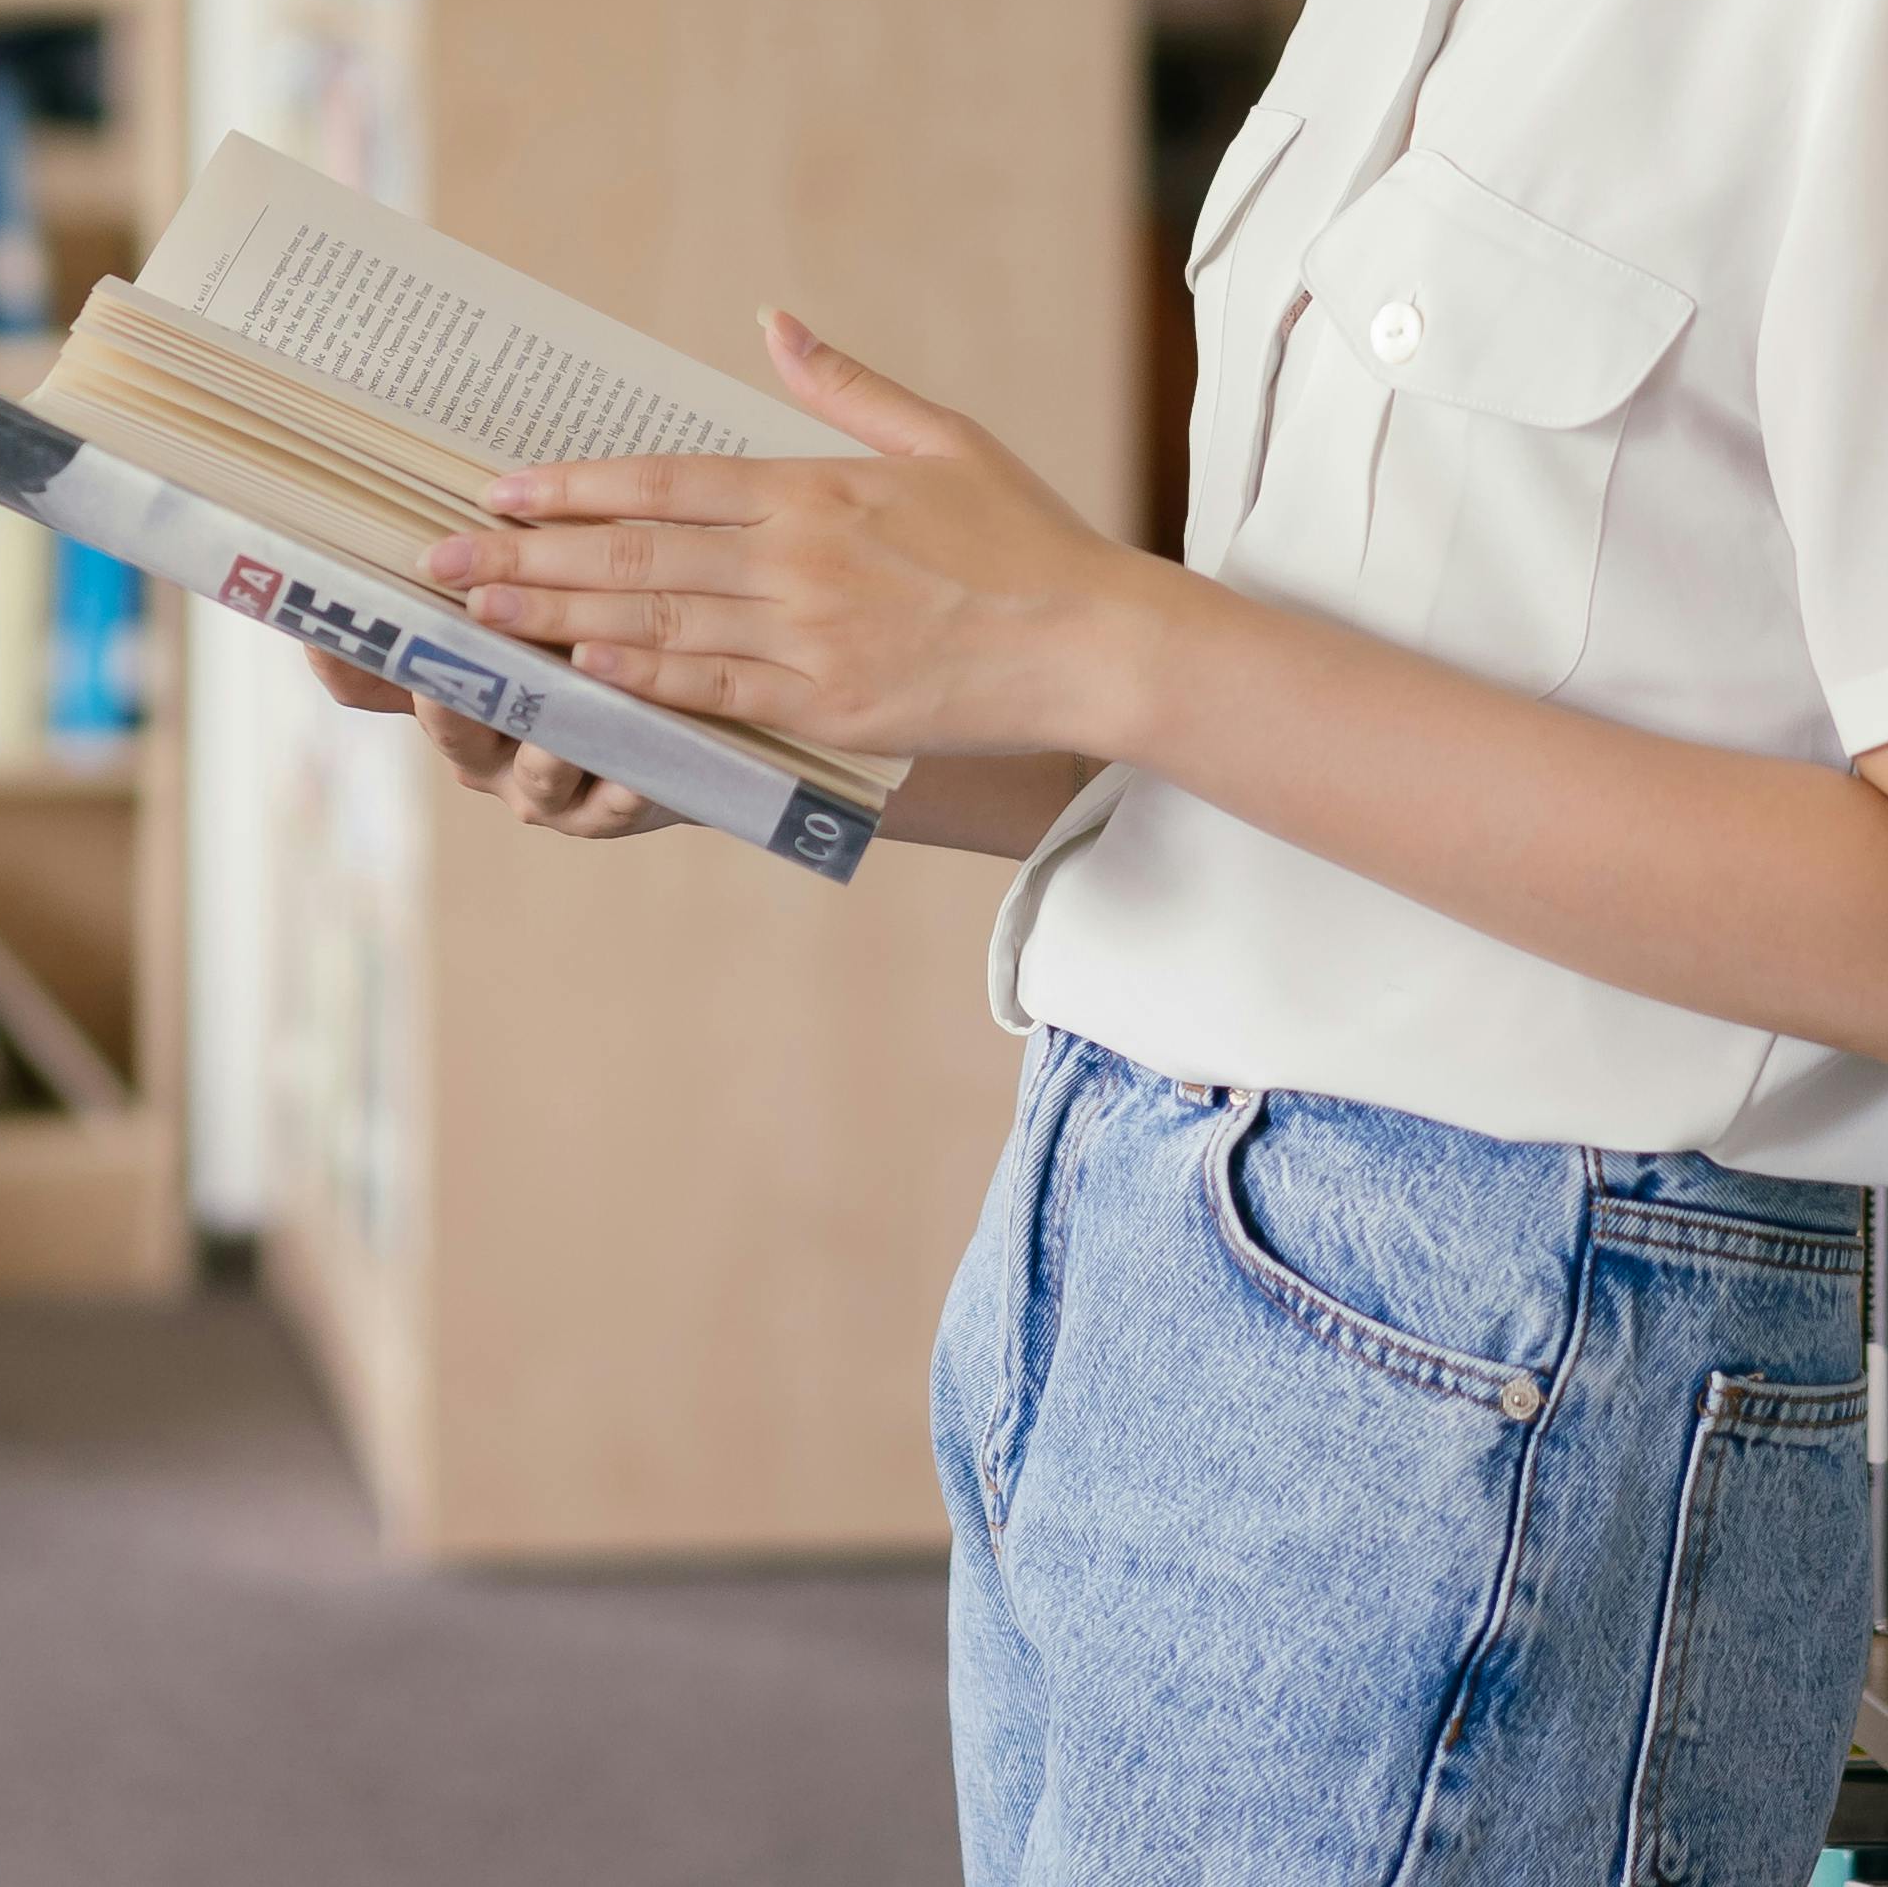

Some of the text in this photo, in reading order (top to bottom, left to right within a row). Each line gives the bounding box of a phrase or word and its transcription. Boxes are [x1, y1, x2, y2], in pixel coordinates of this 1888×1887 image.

[206, 253, 229, 281] Dealers
[260, 255, 313, 332] East Side Operation
[244, 279, 276, 320] Department
[283, 305, 306, 334] the first
[301, 275, 346, 343] dropped by and
[311, 257, 380, 366] the same time, some of the
[358, 305, 397, 366] and reclaiming the
[379, 299, 423, 367] of Operation Pressure
[394, 329, 428, 383] markets did not
[406, 312, 460, 396] because the neighborhood
[426, 355, 459, 408] involvement of
[439, 396, 459, 424] markets
[453, 339, 512, 432] York City Police Department
[478, 372, 518, 436] street enforcement,
[505, 356, 547, 426] to carry out and
[566, 366, 608, 434] Queens, the TNT
[524, 420, 536, 436] area
[528, 408, 542, 420] for
[530, 411, 562, 459] for more than
[578, 388, 619, 453] dealing, but the
[632, 414, 649, 442] generally
[239, 567, 274, 594] A
